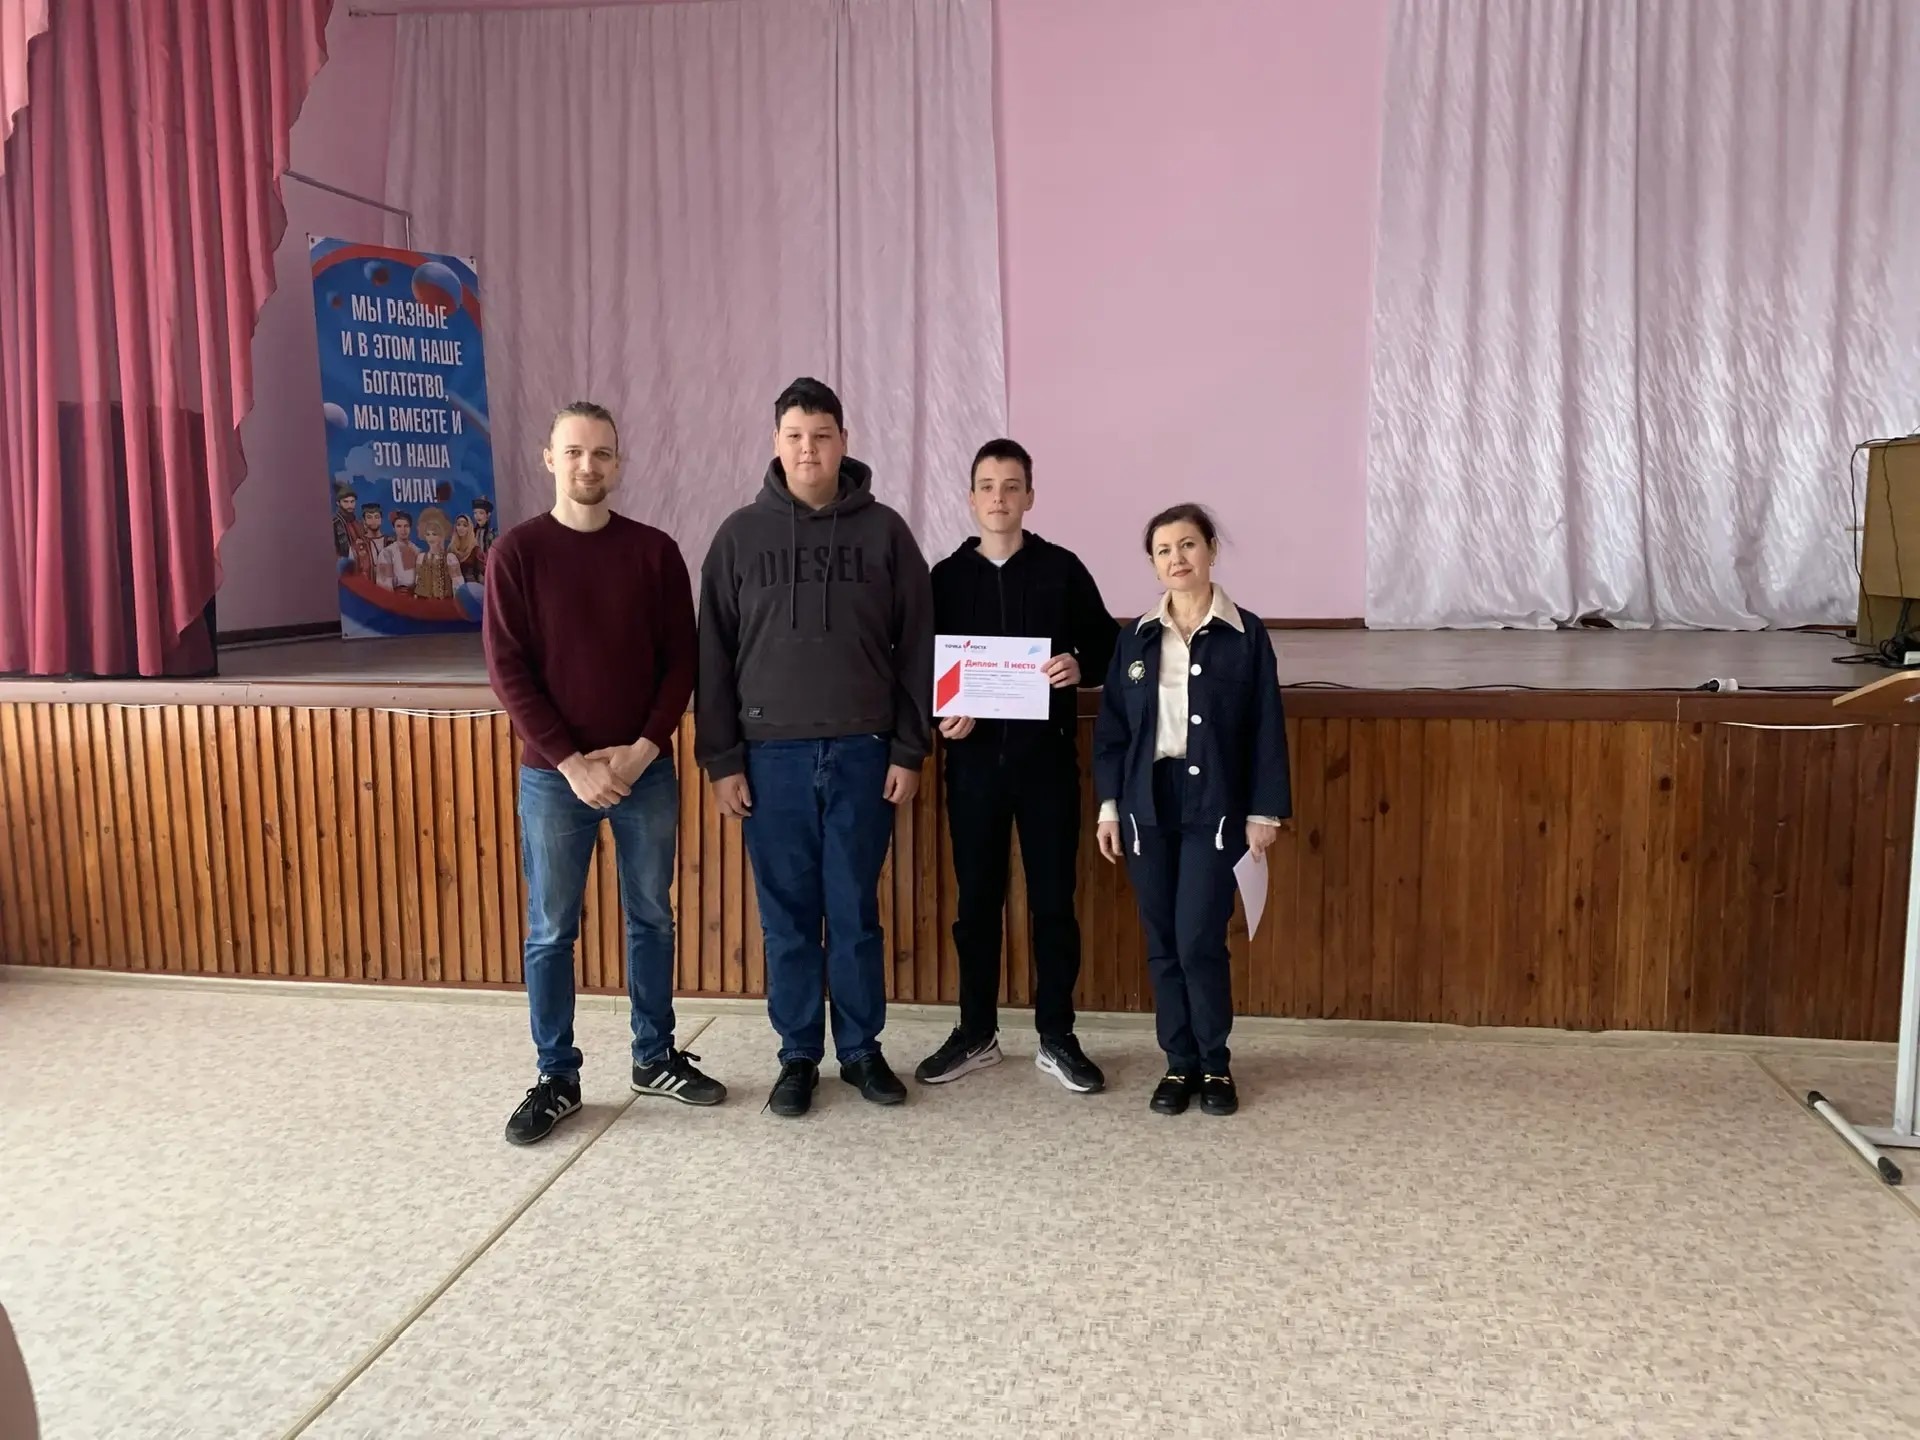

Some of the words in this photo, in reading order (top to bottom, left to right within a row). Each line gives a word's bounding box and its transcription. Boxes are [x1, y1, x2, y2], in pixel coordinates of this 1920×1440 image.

[351, 294, 382, 323] МЫ
[386, 298, 449, 330] РАЗНЫЕ
[341, 330, 353, 356] И
[357, 332, 369, 357] В
[372, 334, 416, 361] ЭТОМ
[420, 338, 463, 366] НАШЕ
[362, 368, 449, 402] БОГАТСТВО,
[353, 404, 385, 431] МЫ
[389, 406, 449, 434] ВМЕСТЕ
[452, 410, 463, 435] И
[372, 441, 402, 467] ЭТО
[406, 443, 451, 469] НАША
[391, 478, 438, 503] СИЛА!
[758, 545, 871, 588] DIESEL
[965, 659, 998, 668] Диплом
[1011, 662, 1036, 670] место
